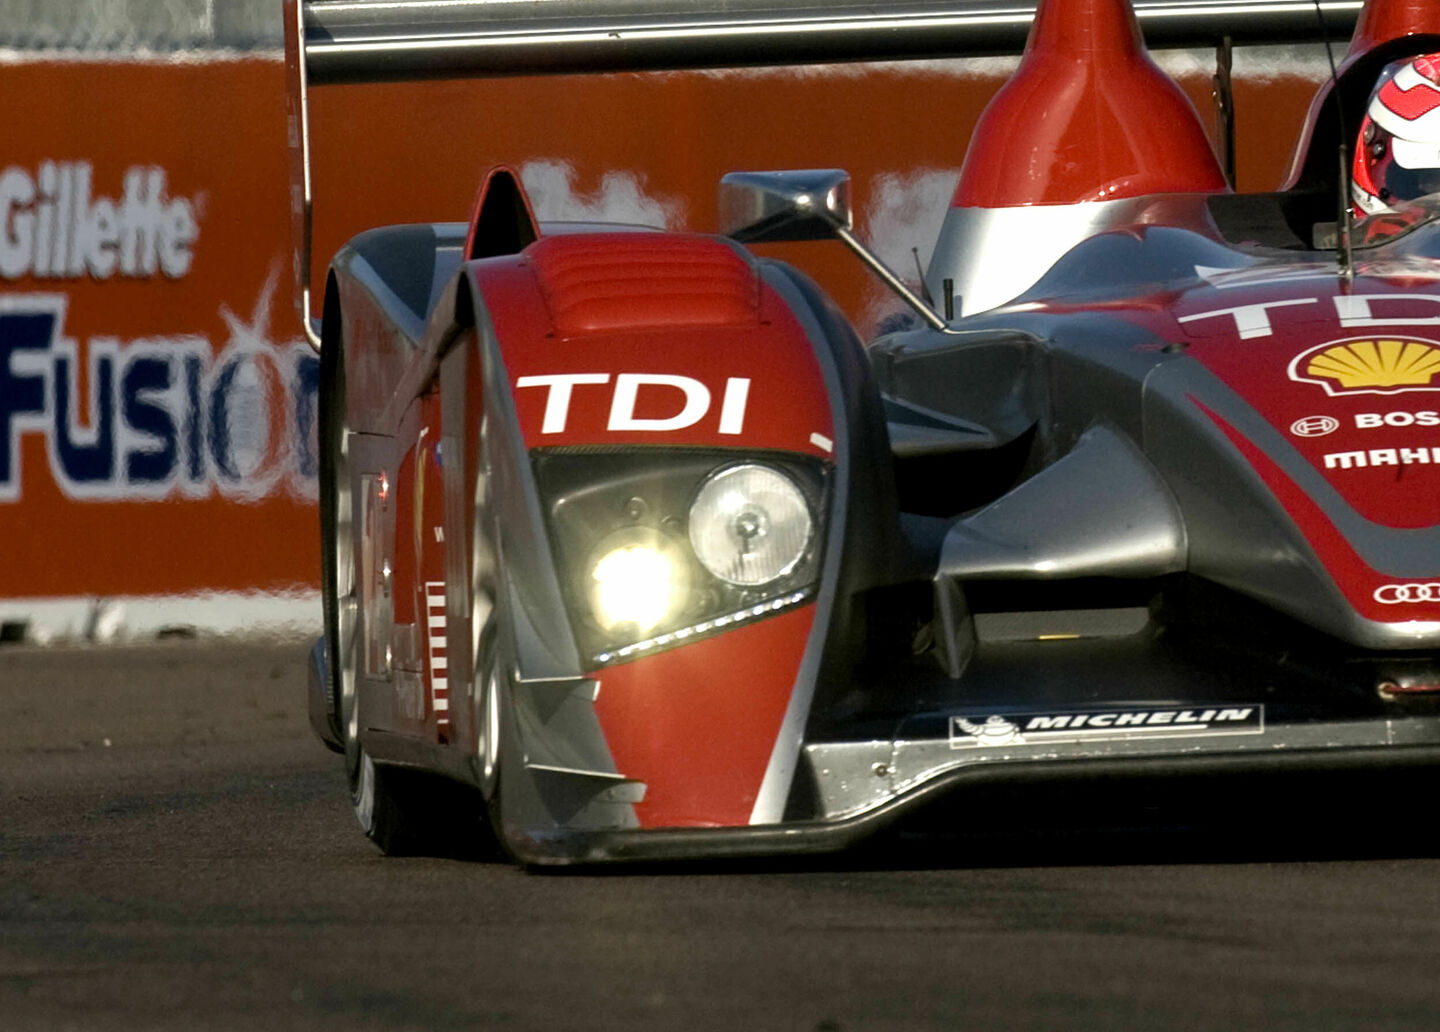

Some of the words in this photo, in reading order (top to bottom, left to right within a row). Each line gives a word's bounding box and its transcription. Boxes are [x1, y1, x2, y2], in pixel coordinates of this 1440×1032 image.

[0, 161, 198, 279] Gillette
[516, 373, 751, 434] TDI
[1025, 708, 1253, 730] MICHELIN
